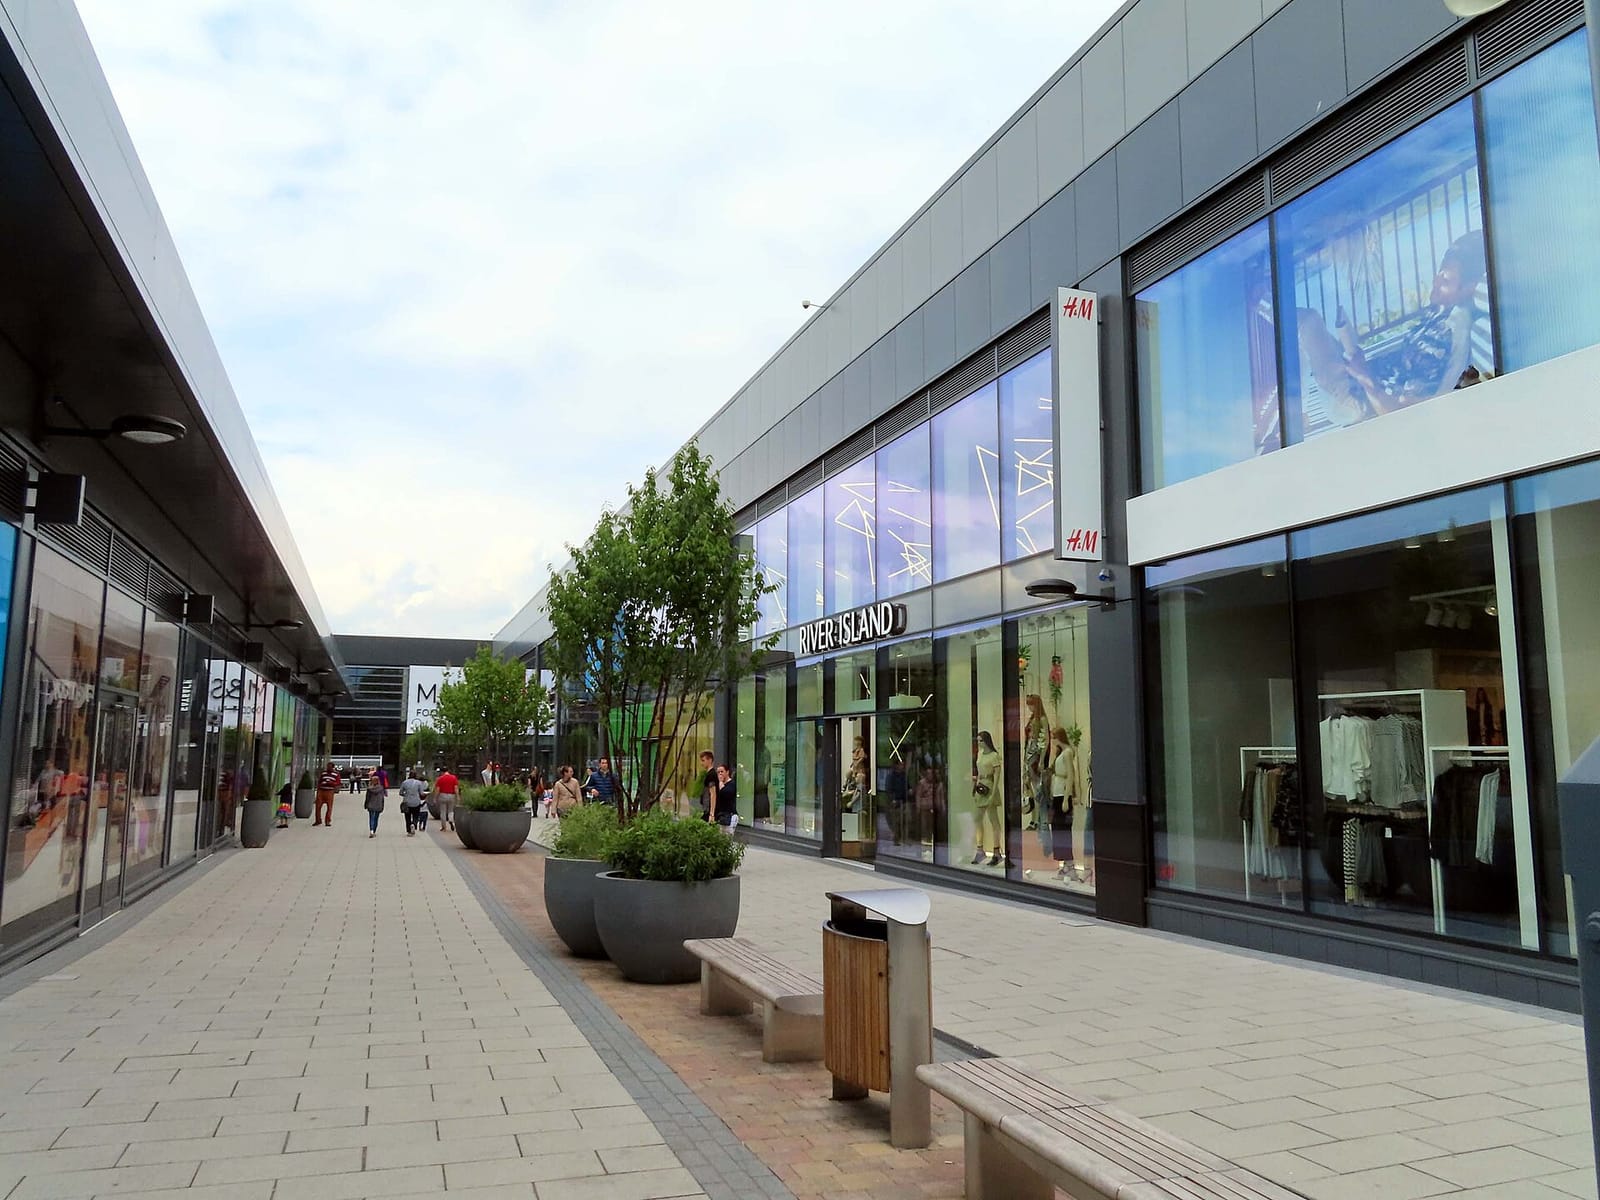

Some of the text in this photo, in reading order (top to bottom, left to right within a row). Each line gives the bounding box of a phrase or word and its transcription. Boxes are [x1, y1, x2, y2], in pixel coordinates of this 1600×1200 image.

[1063, 296, 1094, 321] H&M
[1066, 528, 1098, 554] H&M
[799, 601, 894, 656] RIVER ISLAND
